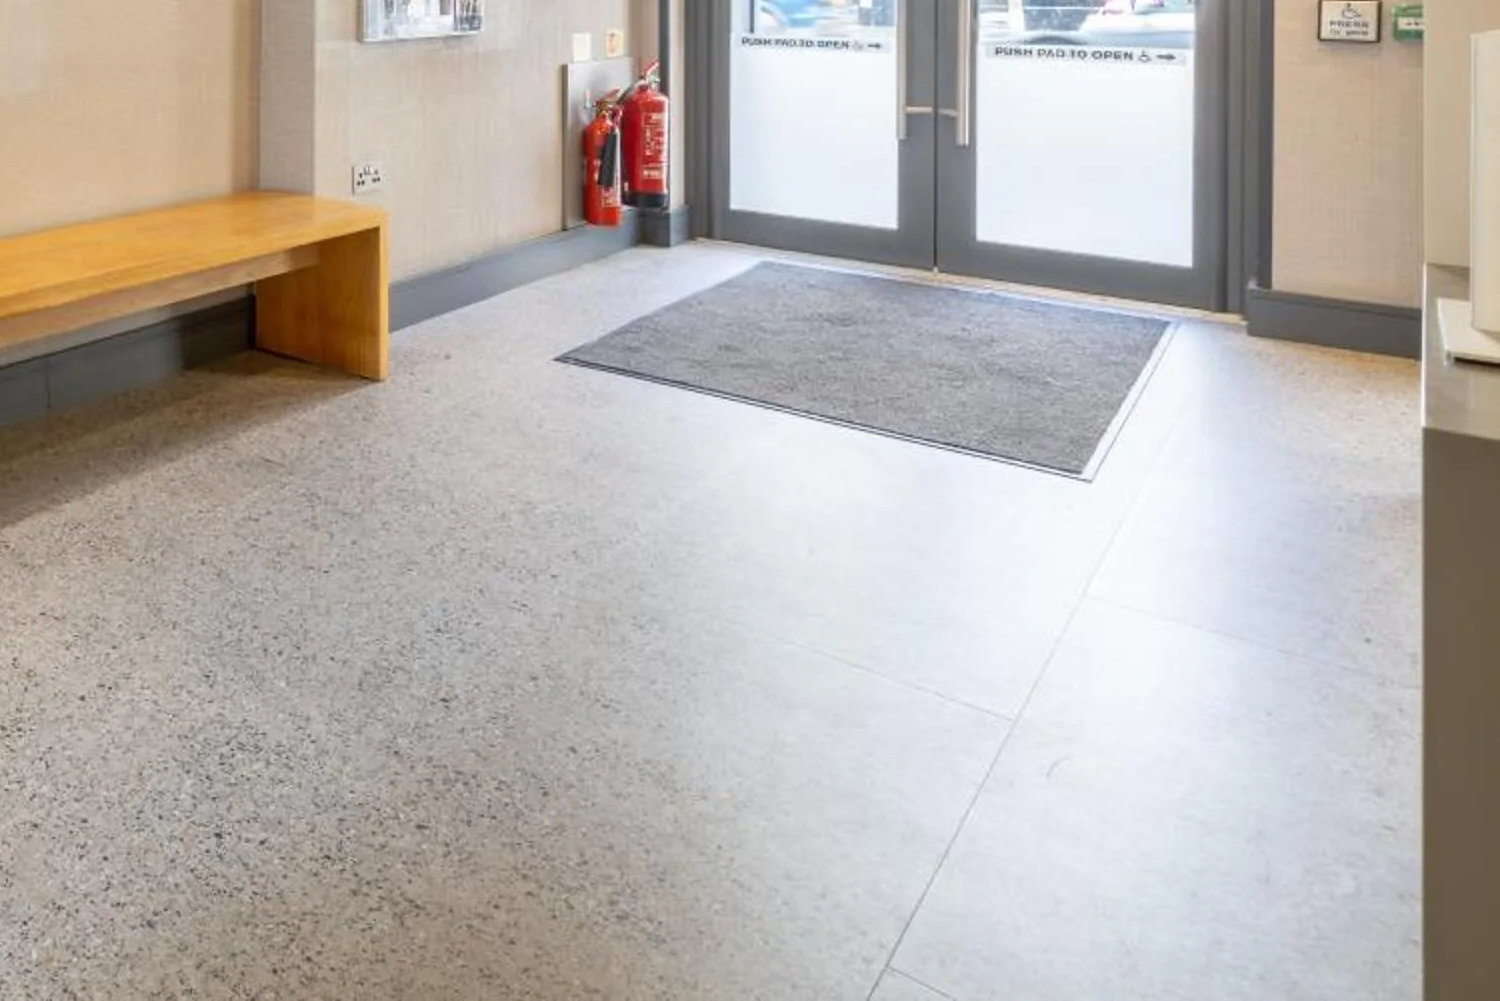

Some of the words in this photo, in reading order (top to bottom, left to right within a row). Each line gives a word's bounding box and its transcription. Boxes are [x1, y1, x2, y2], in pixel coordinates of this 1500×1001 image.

[741, 37, 773, 46] PUSH
[773, 38, 797, 48] PAD
[816, 40, 849, 50] OPEN
[995, 46, 1033, 56] PUSH
[1037, 48, 1065, 58] PAD
[1070, 49, 1088, 60] TO
[1091, 50, 1134, 61] OPEN
